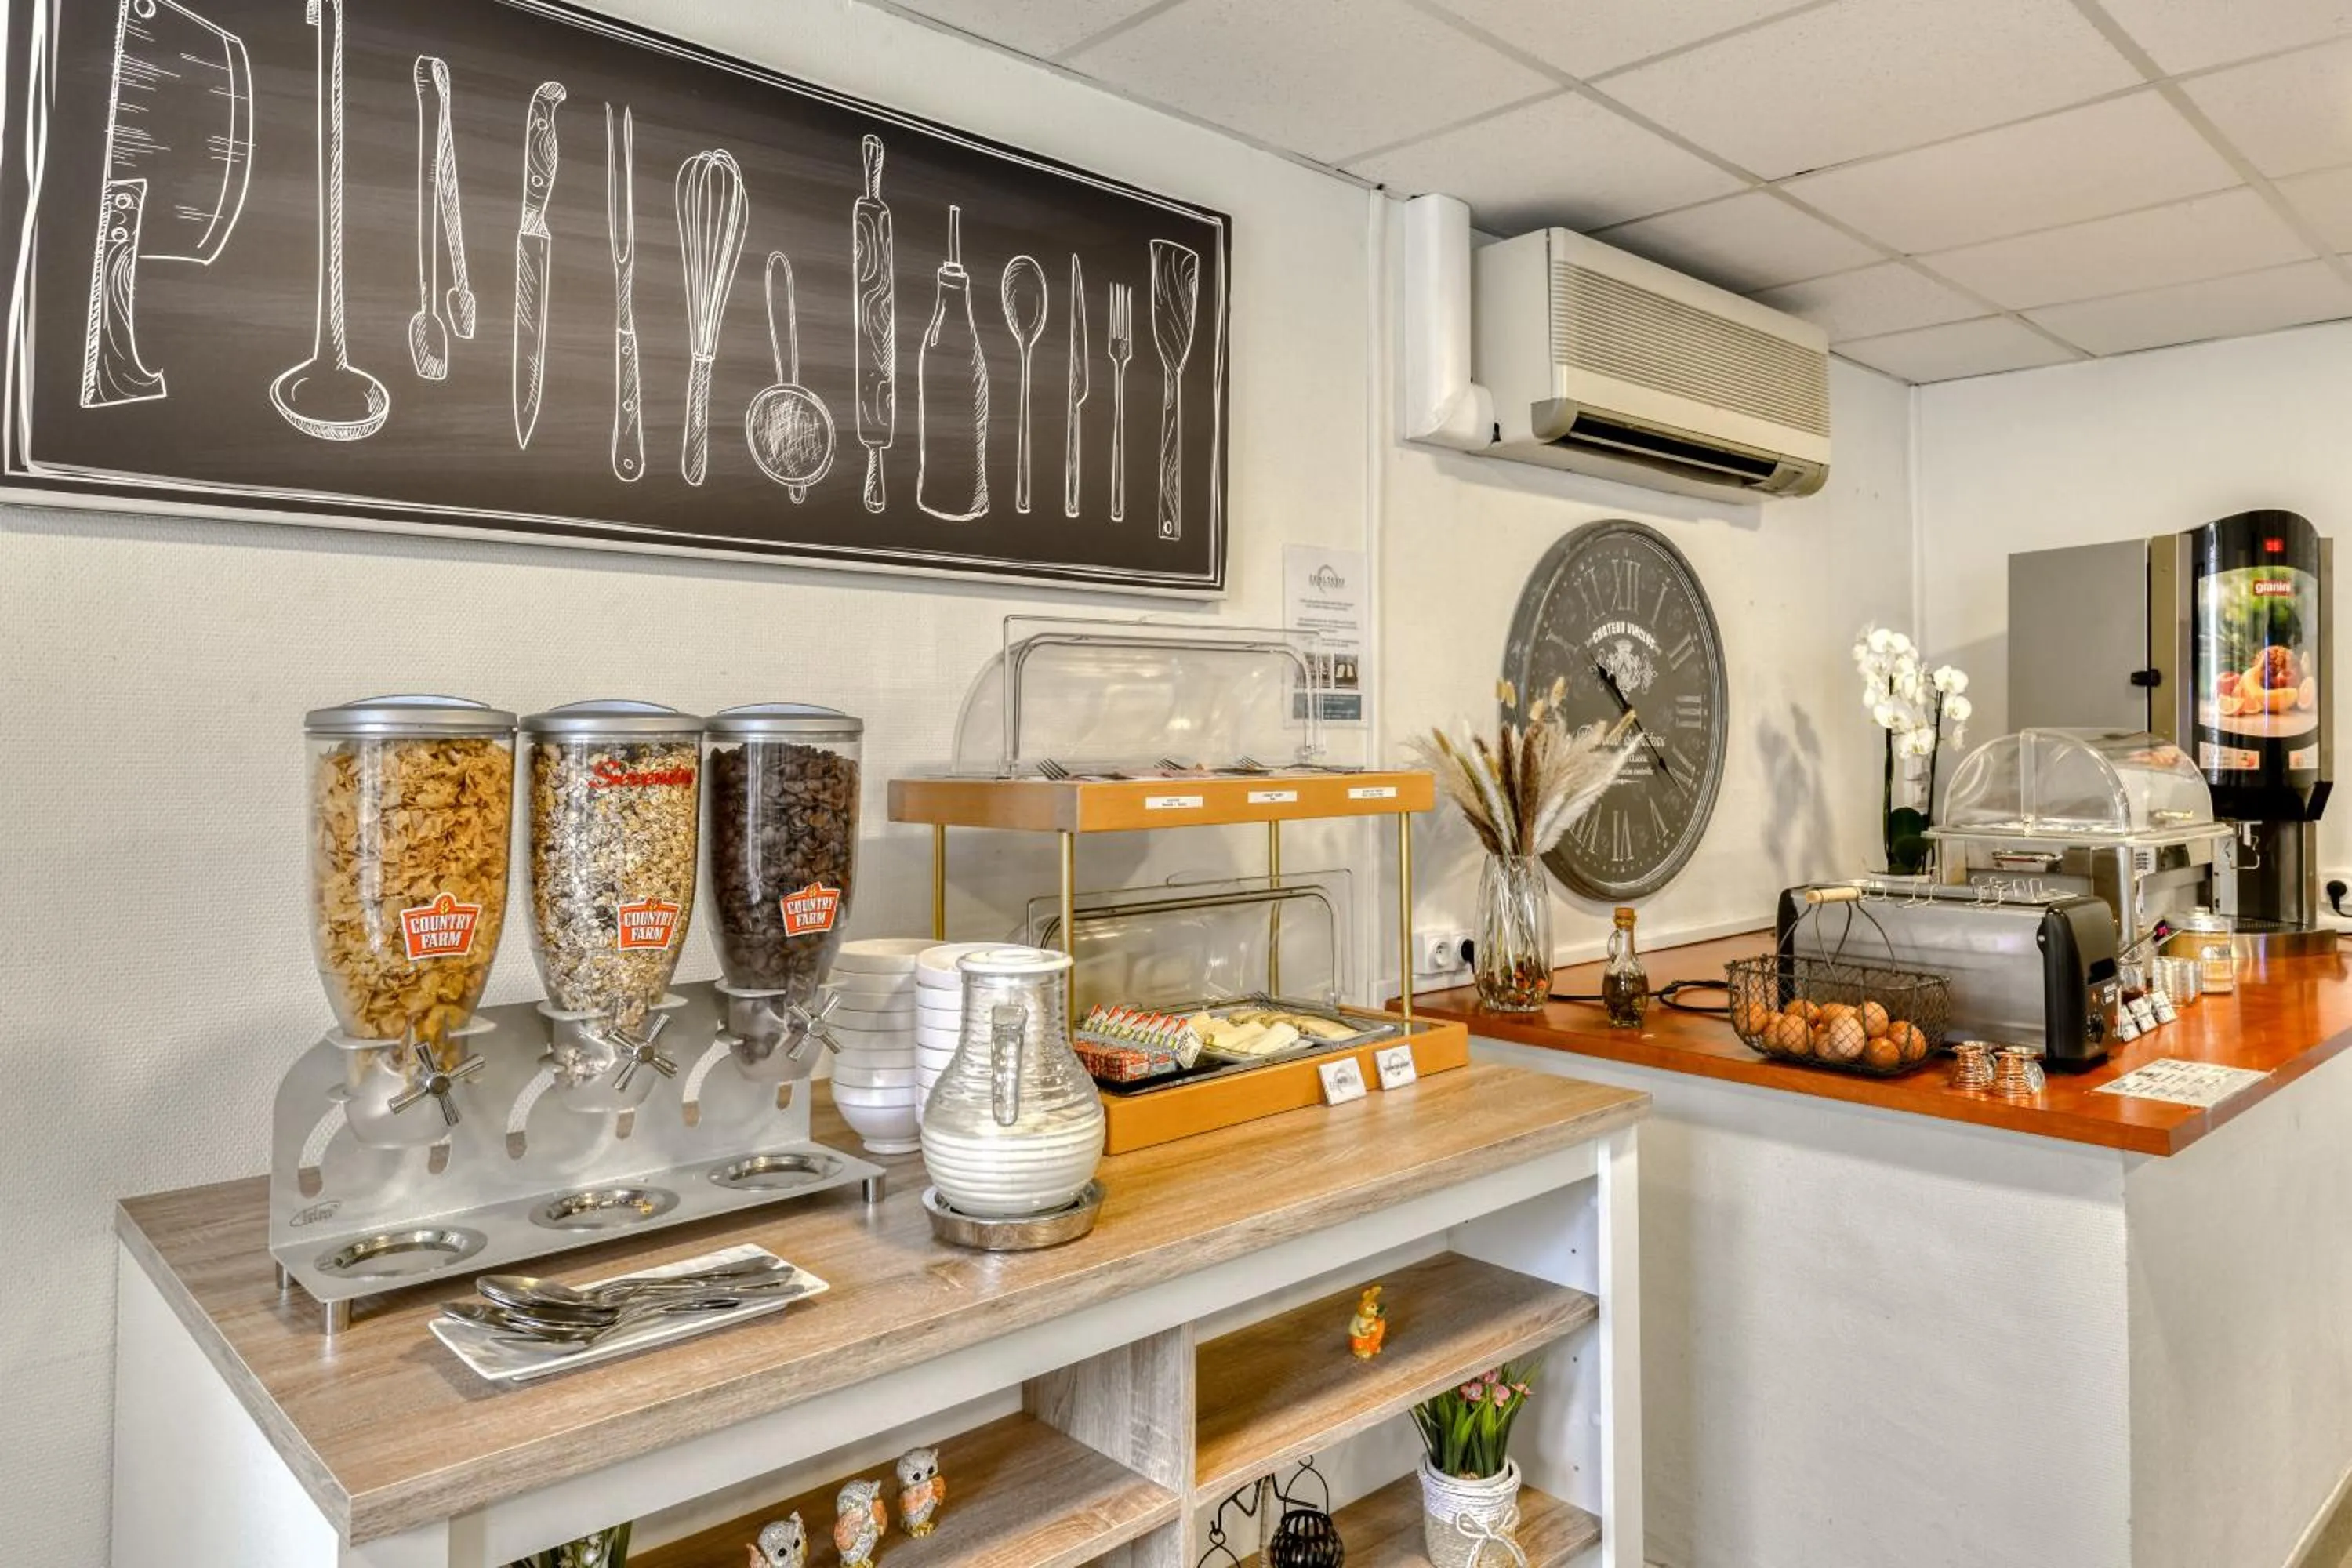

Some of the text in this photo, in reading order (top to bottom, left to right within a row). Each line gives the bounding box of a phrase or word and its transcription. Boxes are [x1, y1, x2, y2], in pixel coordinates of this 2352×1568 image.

[2255, 583, 2291, 594] granini
[786, 895, 836, 915] COUNTRY
[410, 913, 474, 934] COUNTRY
[624, 911, 676, 927] COUNTRY
[796, 911, 826, 927] FARM
[420, 931, 463, 949] FARM
[631, 926, 666, 942] FARM
